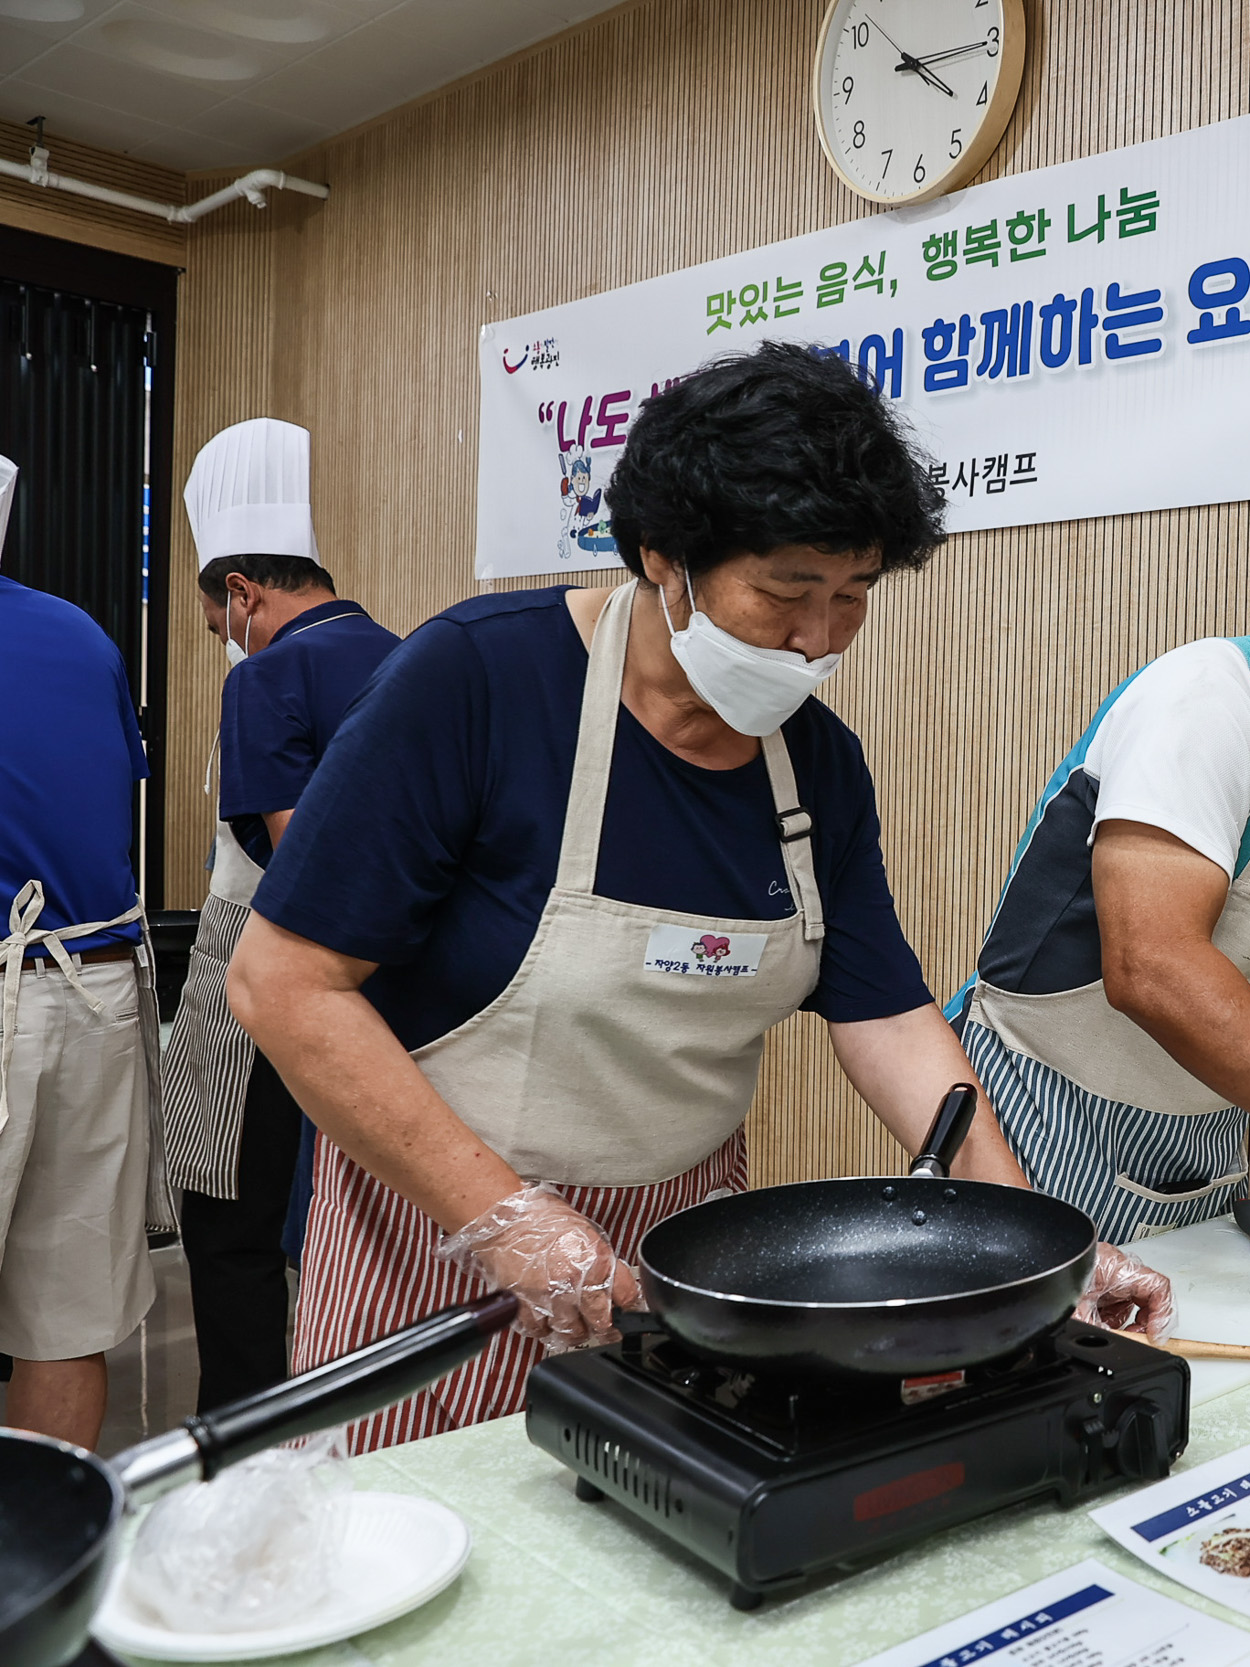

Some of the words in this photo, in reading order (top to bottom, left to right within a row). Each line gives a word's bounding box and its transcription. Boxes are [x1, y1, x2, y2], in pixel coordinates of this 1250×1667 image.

[851, 21, 870, 50] 10
[986, 26, 1000, 58] 3
[842, 76, 854, 105] 9
[976, 80, 988, 106] 4
[852, 120, 866, 149] 8
[949, 128, 962, 159] 5
[881, 149, 894, 180] 7
[913, 153, 926, 184] 6
[705, 276, 804, 335] 맛있는
[815, 250, 899, 308] 음식,
[921, 208, 1052, 283] 행복한
[1067, 187, 1160, 244] 나눔
[921, 281, 1165, 394] 함께하는
[654, 959, 690, 974] 자양2동
[695, 963, 749, 976] 자원봉사캠프
